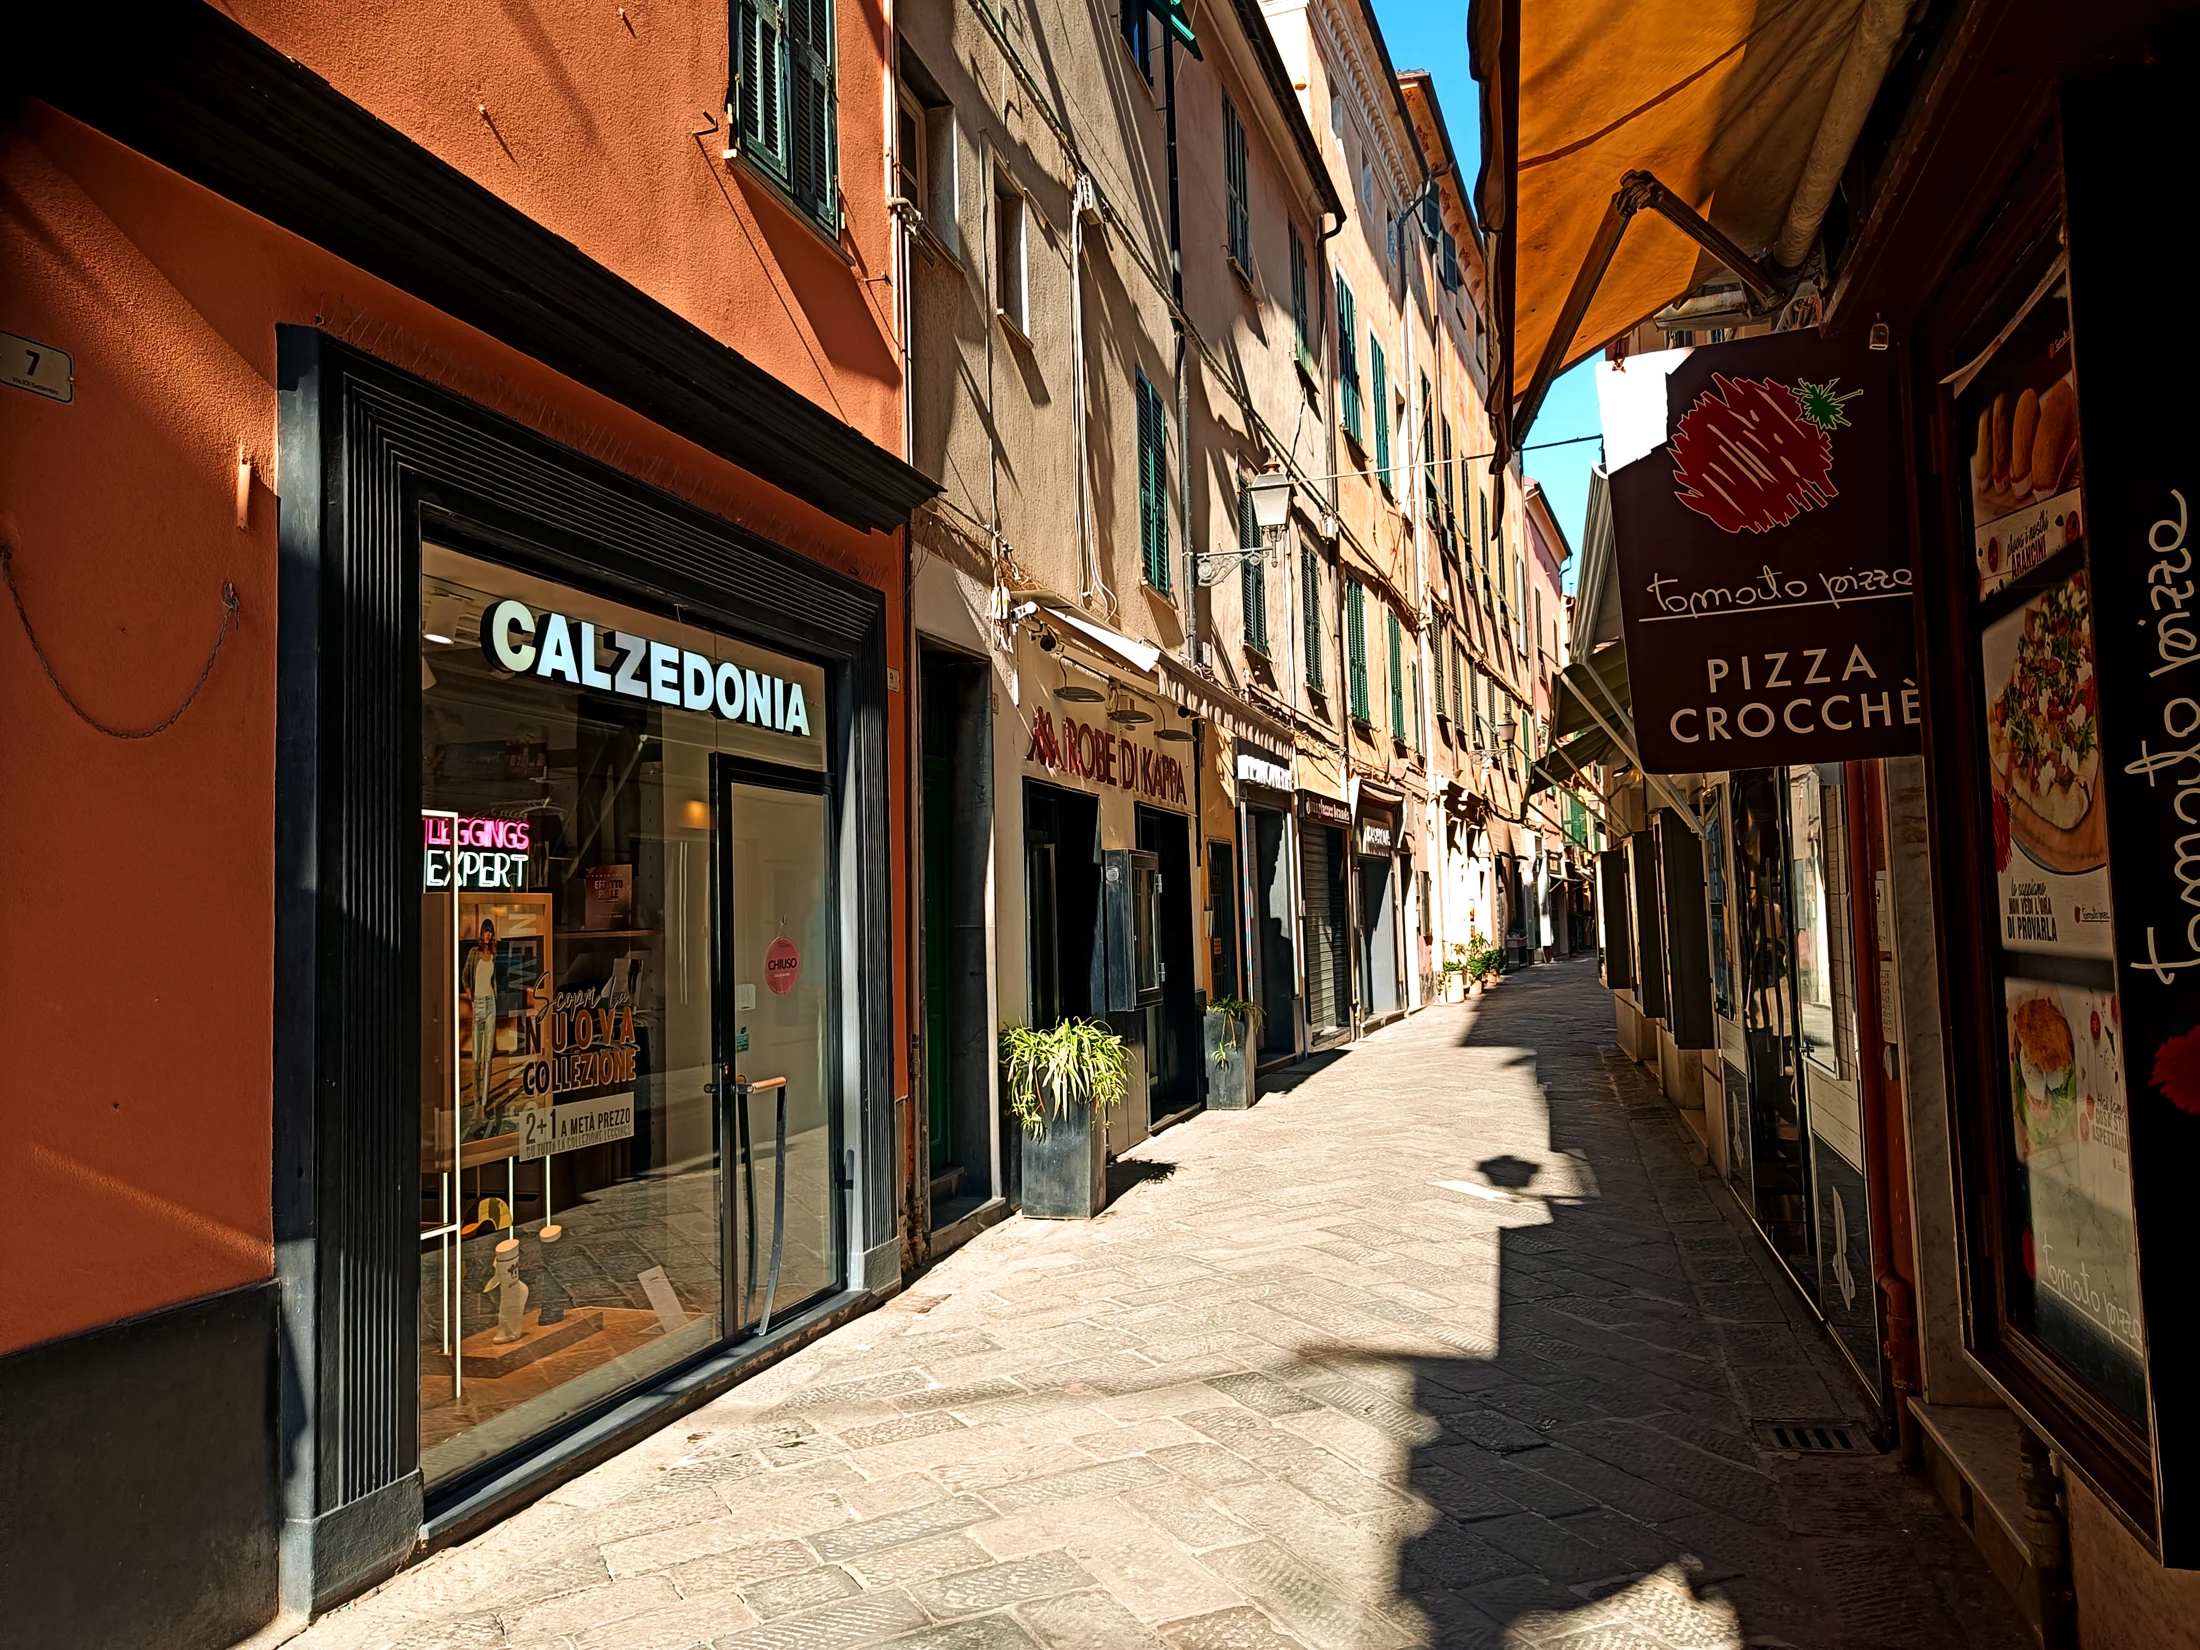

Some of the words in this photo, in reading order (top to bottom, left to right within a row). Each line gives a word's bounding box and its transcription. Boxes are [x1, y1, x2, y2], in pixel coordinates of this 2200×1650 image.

[26, 349, 40, 377] 7
[2012, 534, 2047, 580] ARANCINI
[1646, 565, 1808, 619] tomato
[2137, 487, 2200, 679] pizza
[484, 600, 811, 737] CALZEDONIA
[1706, 643, 1878, 693] PIZZA
[1669, 677, 1921, 743] CROCCHÈ
[1063, 716, 1118, 787] ROBE
[1119, 738, 1139, 792] DI
[1141, 747, 1188, 806] KAPPA
[427, 816, 530, 850] LEGGINGS
[1333, 803, 1350, 822] brands
[426, 849, 530, 888] EXPERT
[2007, 916, 2016, 940] DI
[2017, 916, 2058, 942] PROVARLA
[767, 958, 798, 971] CHIUSO
[525, 1006, 636, 1056] NUOVA
[523, 1049, 637, 1098] COLLEZIONE
[526, 1108, 557, 1145] 2+1
[560, 1120, 568, 1138] A
[570, 1111, 595, 1136] METÀ
[597, 1107, 631, 1131] PREZZO
[526, 1146, 536, 1159] SU
[536, 1141, 557, 1156] TUTTA
[557, 1138, 567, 1151] LA
[567, 1131, 602, 1150] COLLEZIONE
[2042, 1232, 2100, 1313] tomato
